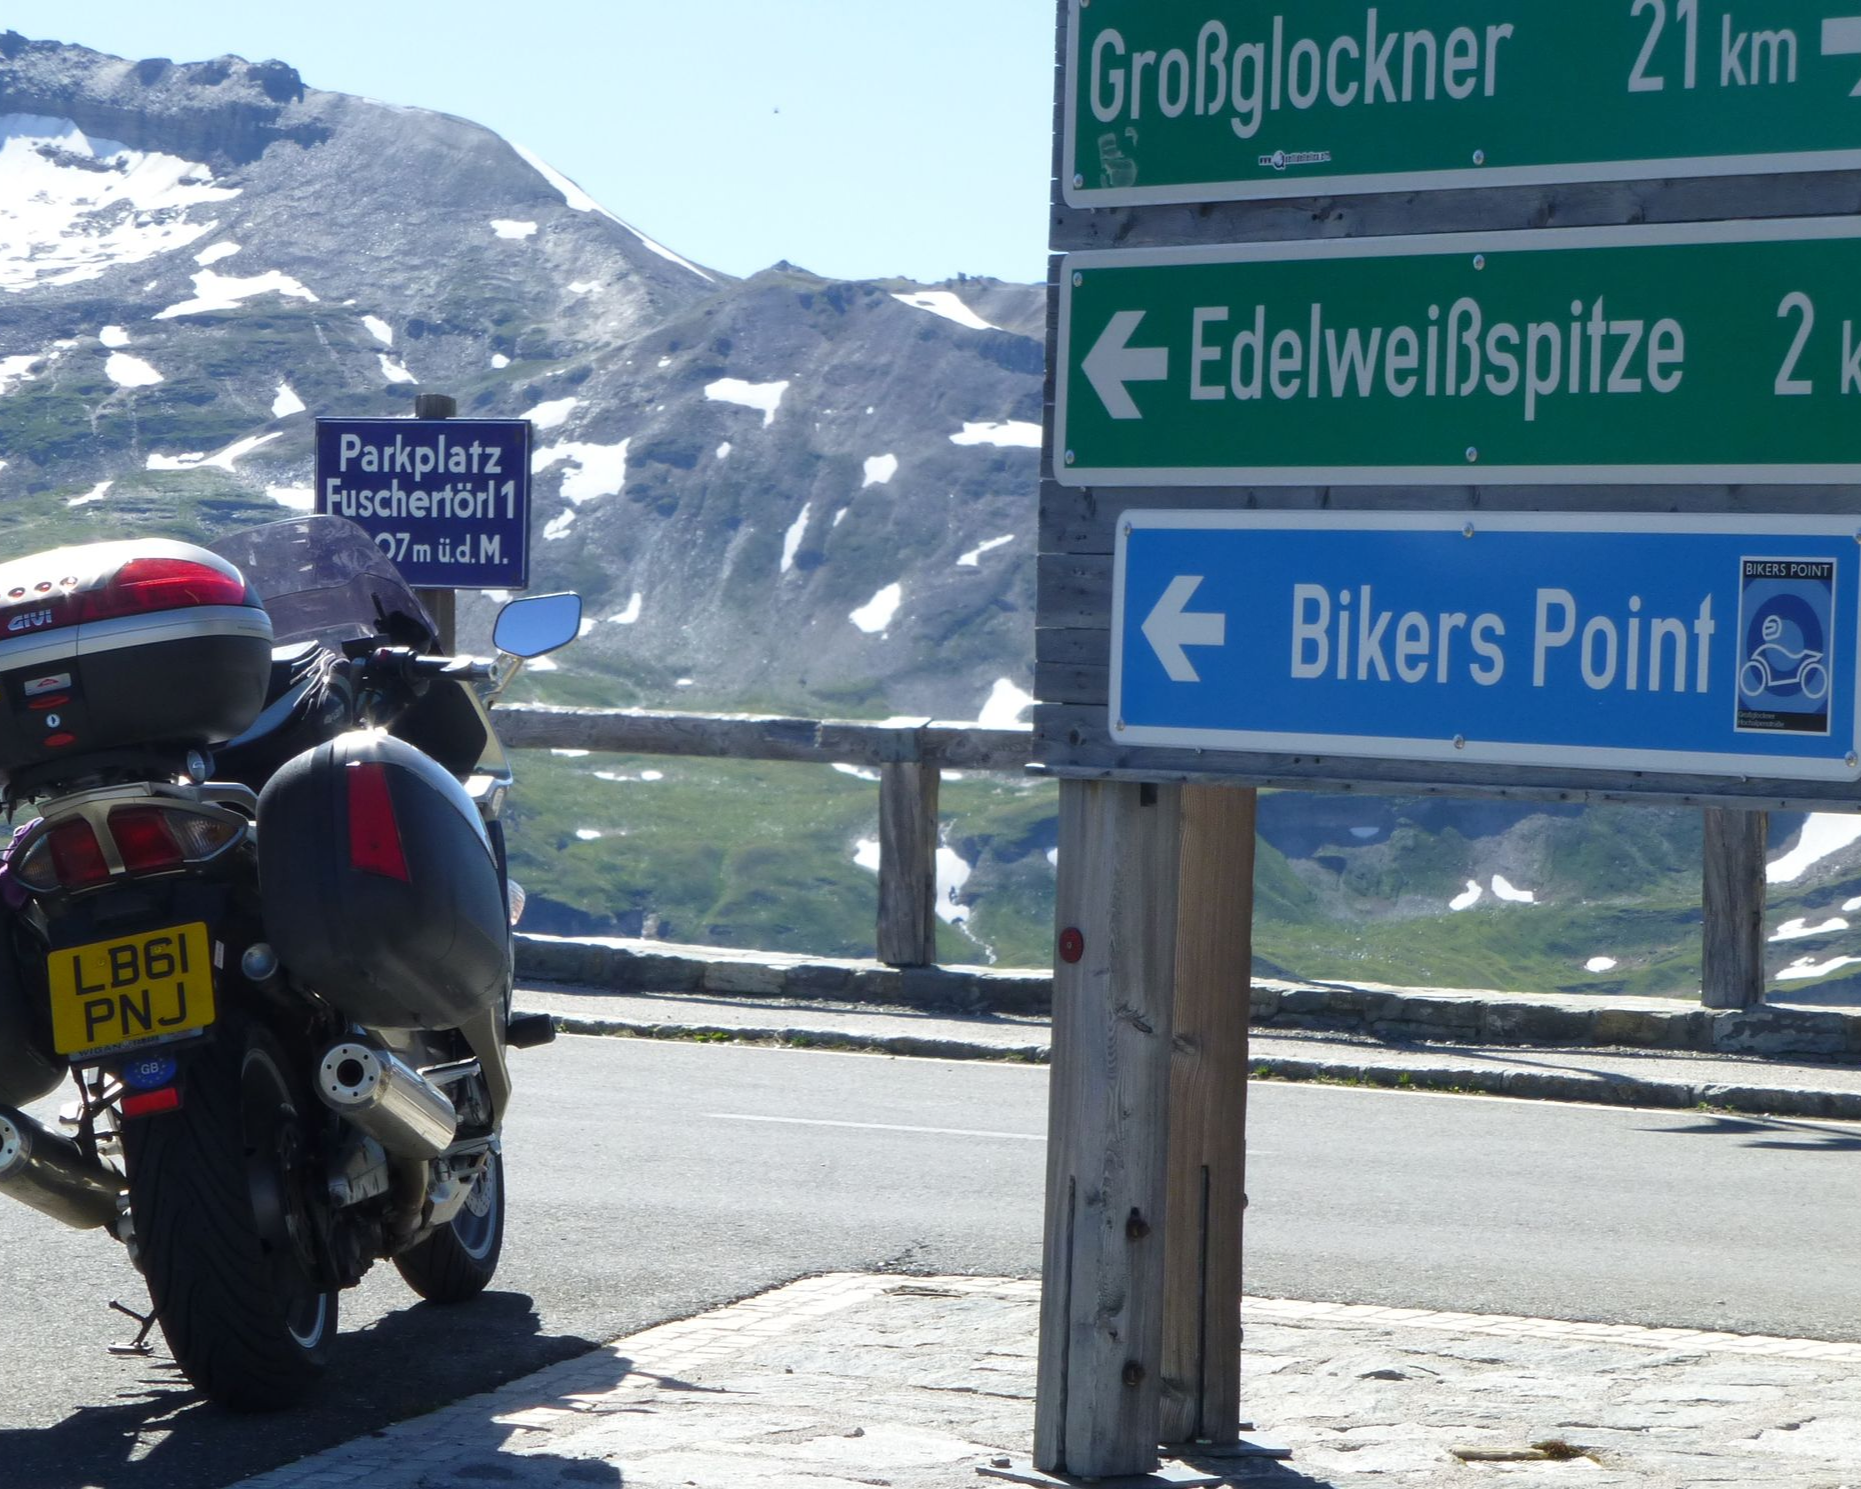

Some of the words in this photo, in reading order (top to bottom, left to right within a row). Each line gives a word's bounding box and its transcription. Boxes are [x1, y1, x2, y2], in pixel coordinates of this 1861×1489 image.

[1090, 8, 1514, 139] Großglockner
[1628, 0, 1698, 92] 21
[1720, 14, 1797, 87] km
[1189, 295, 1684, 421] Edelweißspitze
[1774, 291, 1815, 395] 2
[1841, 320, 1861, 394] k
[340, 434, 502, 482] Parkplatz
[326, 478, 496, 519] Fuschertörl
[1745, 563, 1786, 576] BIKERS
[1790, 564, 1831, 577] POINT
[7, 609, 53, 631] GIVI
[1290, 584, 1504, 686] Bikers
[1532, 588, 1715, 694] Point
[73, 933, 189, 996] LB61
[84, 982, 187, 1043] PNJ
[141, 1062, 159, 1074] GB
